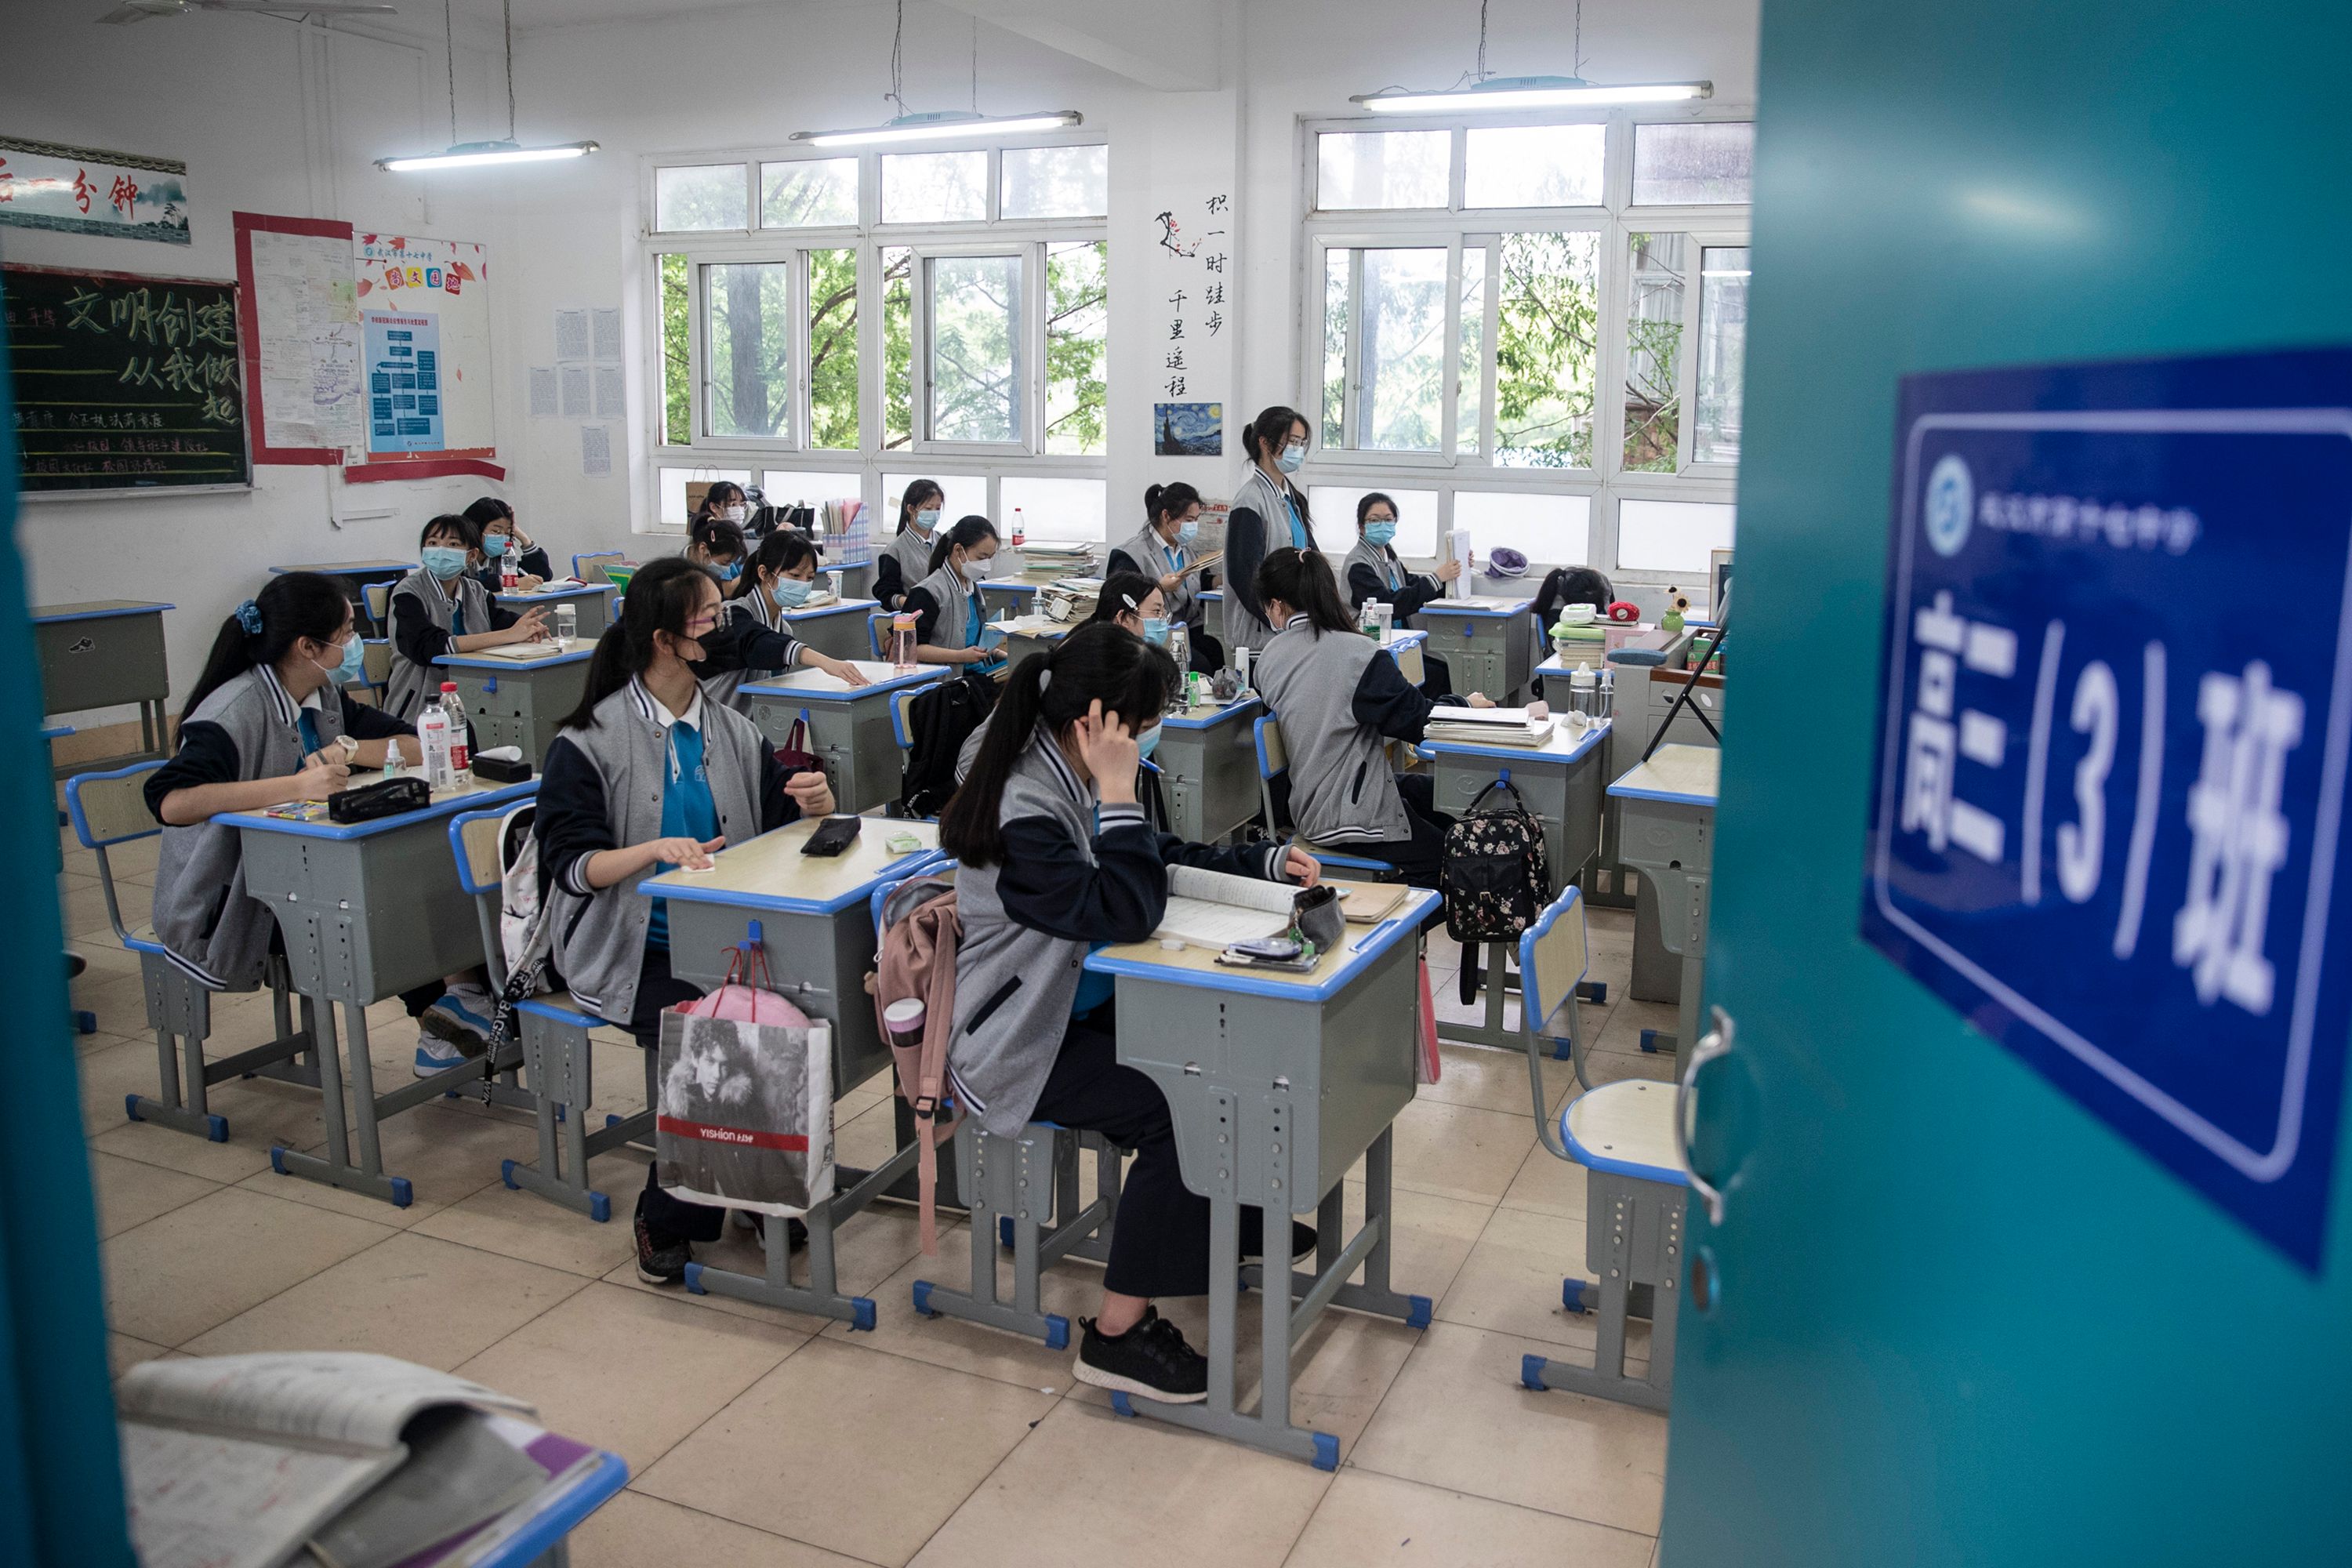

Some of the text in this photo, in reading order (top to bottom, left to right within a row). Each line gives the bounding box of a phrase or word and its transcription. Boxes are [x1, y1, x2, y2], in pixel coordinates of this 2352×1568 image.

[64, 285, 238, 348] 文明创建
[1165, 289, 1188, 397] 千里遥程
